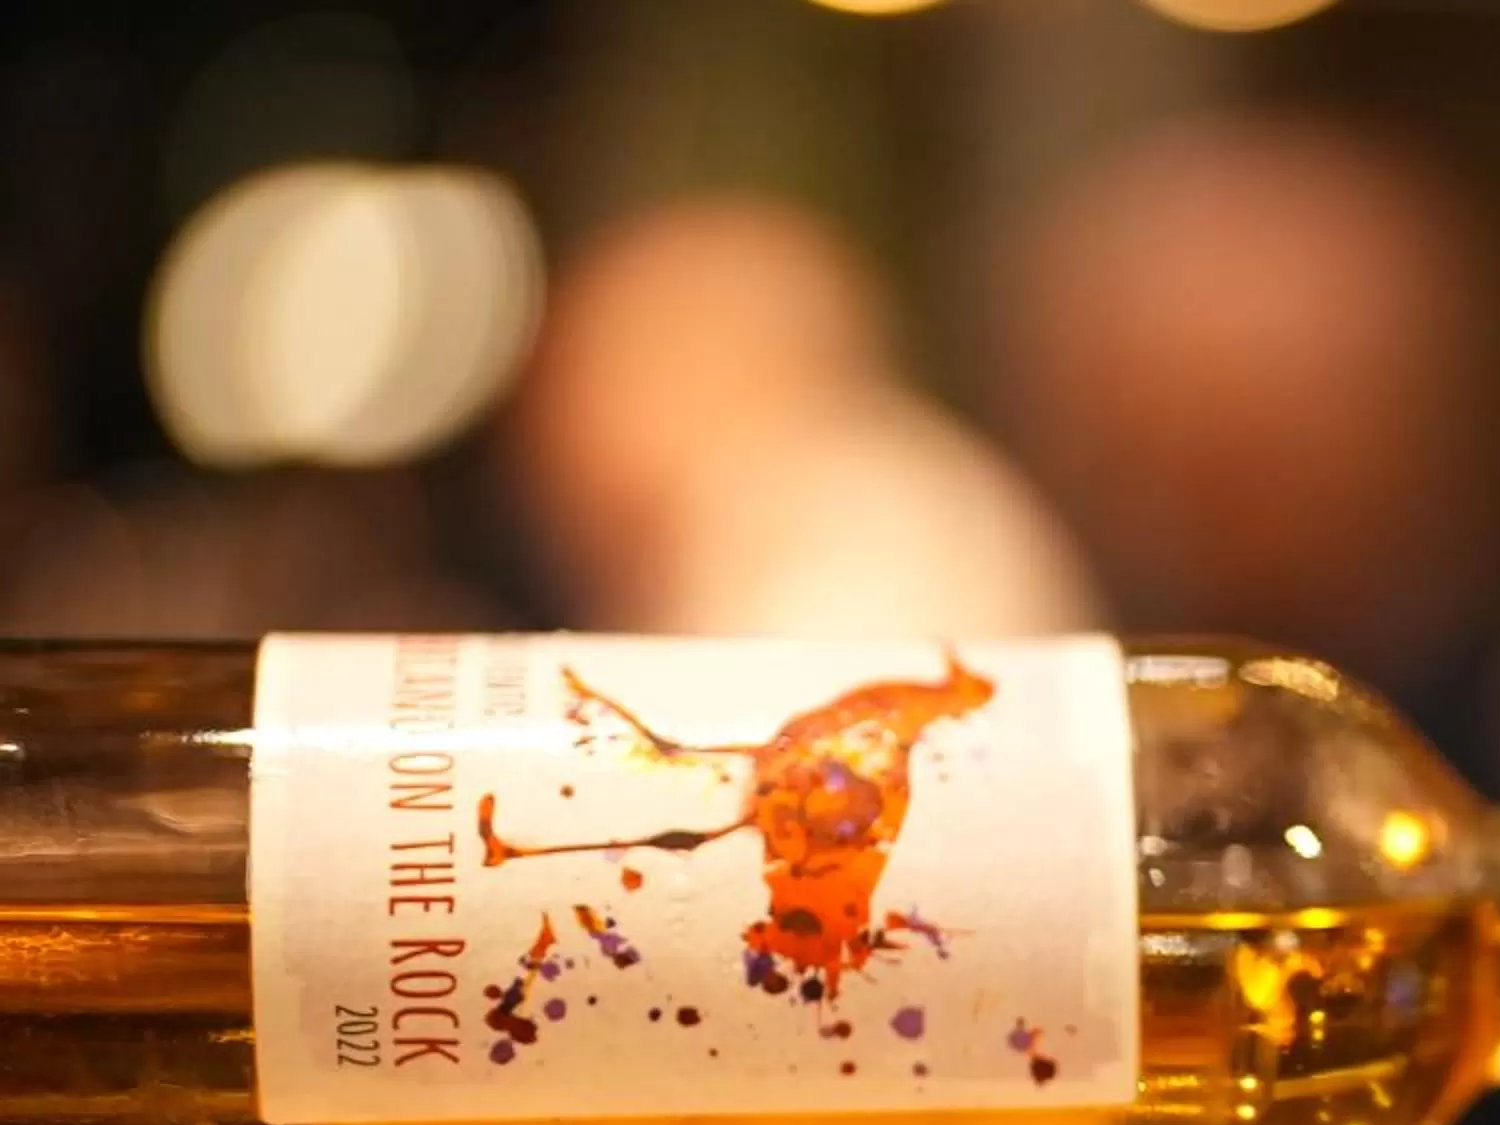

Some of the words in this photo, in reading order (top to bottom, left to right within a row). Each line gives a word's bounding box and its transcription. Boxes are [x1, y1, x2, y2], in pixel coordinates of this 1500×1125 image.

[388, 752, 455, 811] ON
[388, 832, 457, 917] THE
[334, 1004, 382, 1069] 2022
[388, 939, 466, 1068] ROCK
